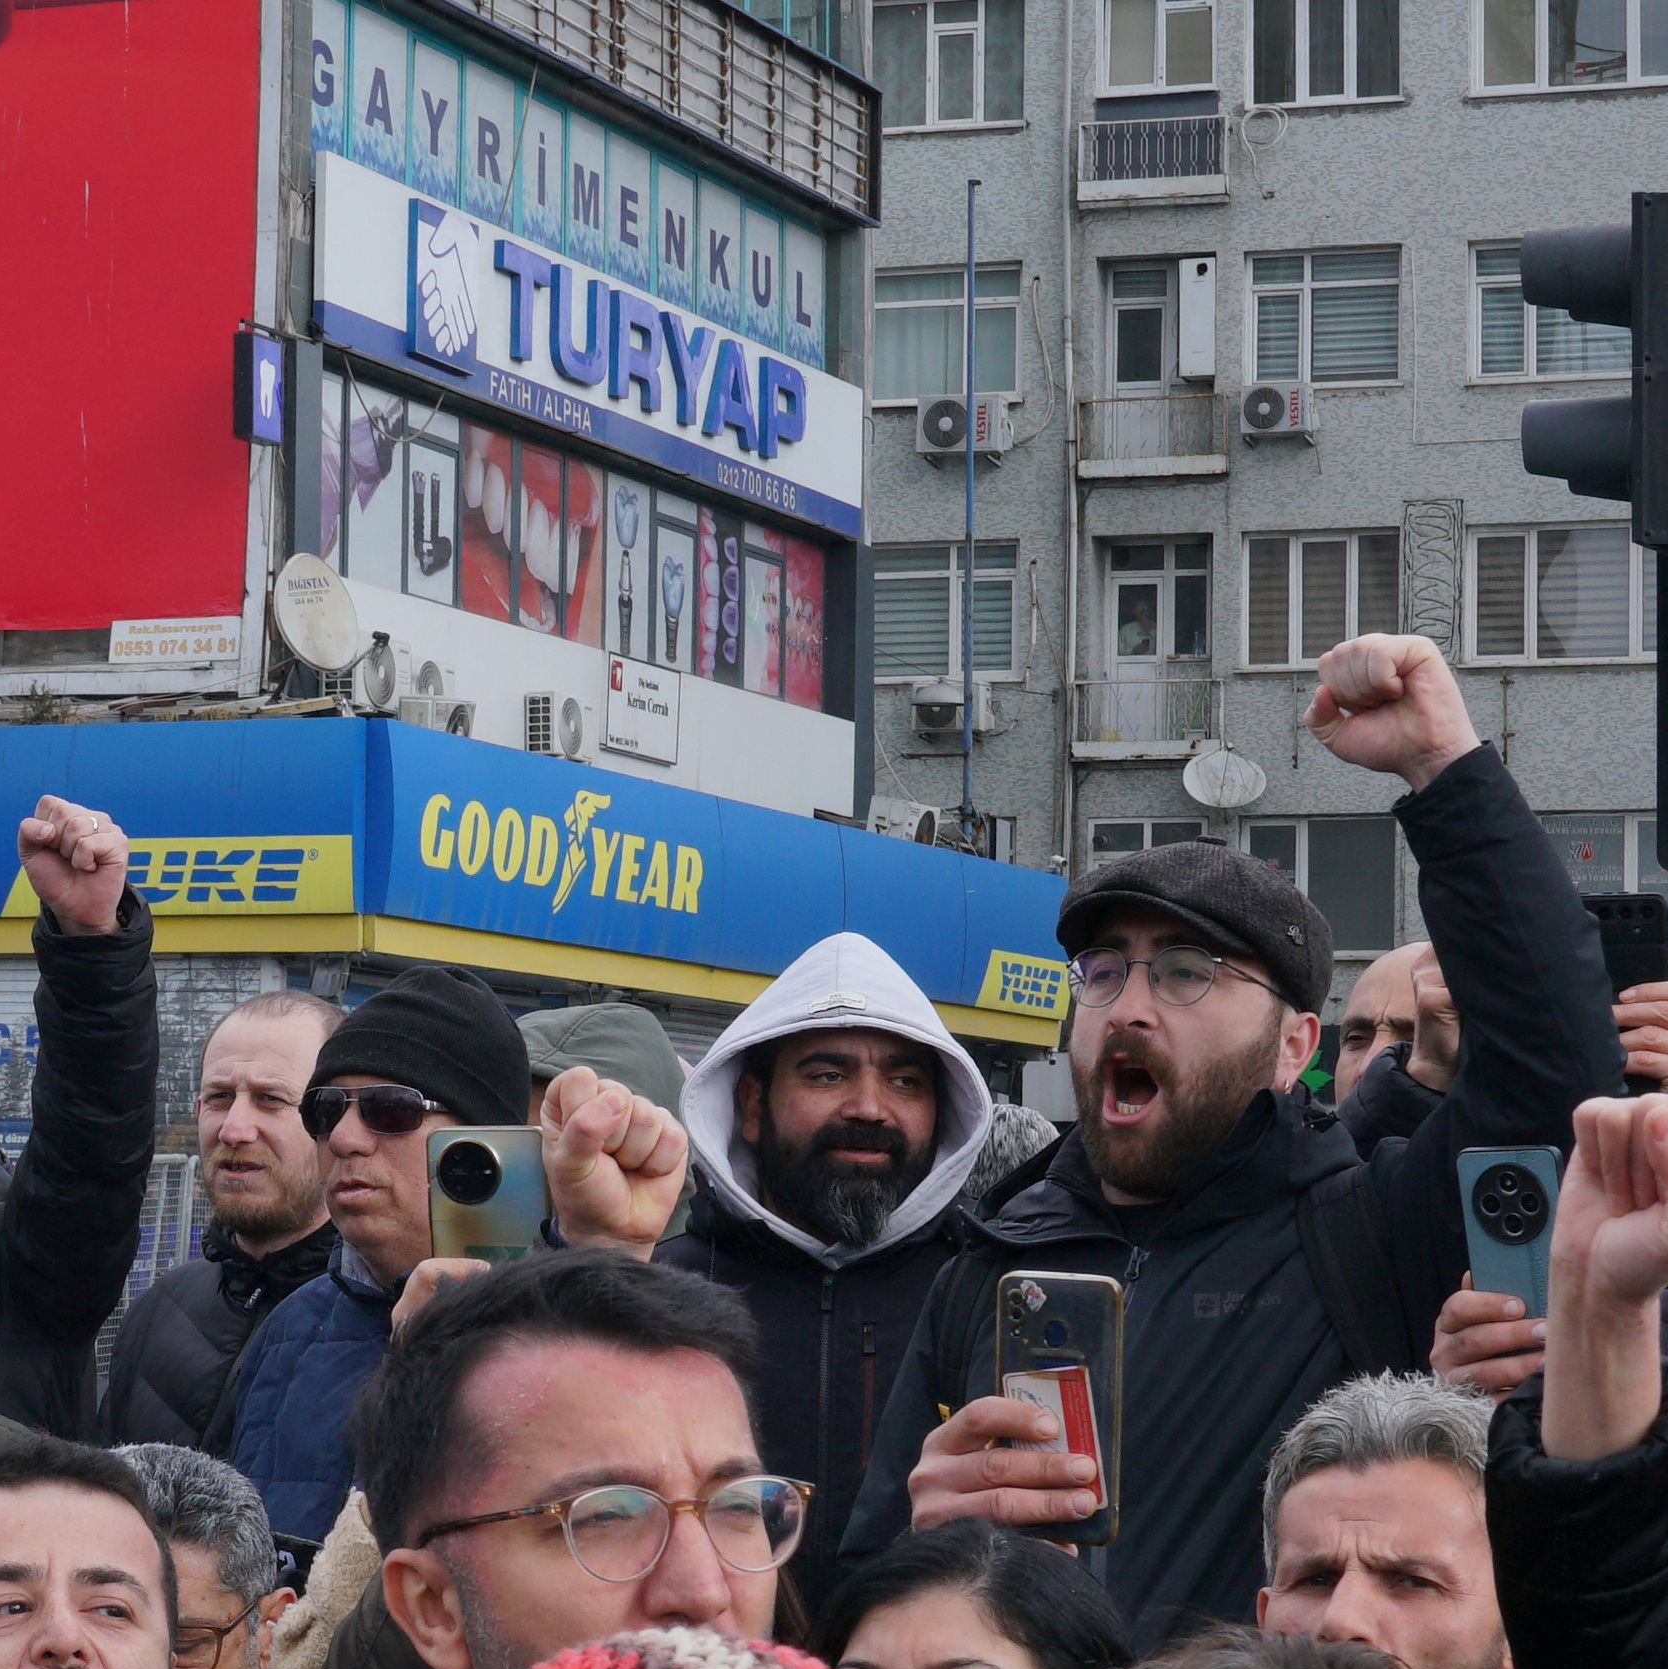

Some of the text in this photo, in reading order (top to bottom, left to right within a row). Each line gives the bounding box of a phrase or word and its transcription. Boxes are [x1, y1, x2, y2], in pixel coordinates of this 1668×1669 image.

[312, 38, 812, 328] GAYRİMENKUL
[494, 239, 807, 459] TURYAP
[543, 391, 592, 434] ALPHA
[976, 402, 987, 442] VESTEL
[1289, 388, 1300, 427] VESTEL
[718, 462, 796, 510] 0212 700 66 66
[113, 637, 236, 657] 0553 074 34 81
[127, 848, 305, 903] UKE
[999, 961, 1061, 1009] YUKE
